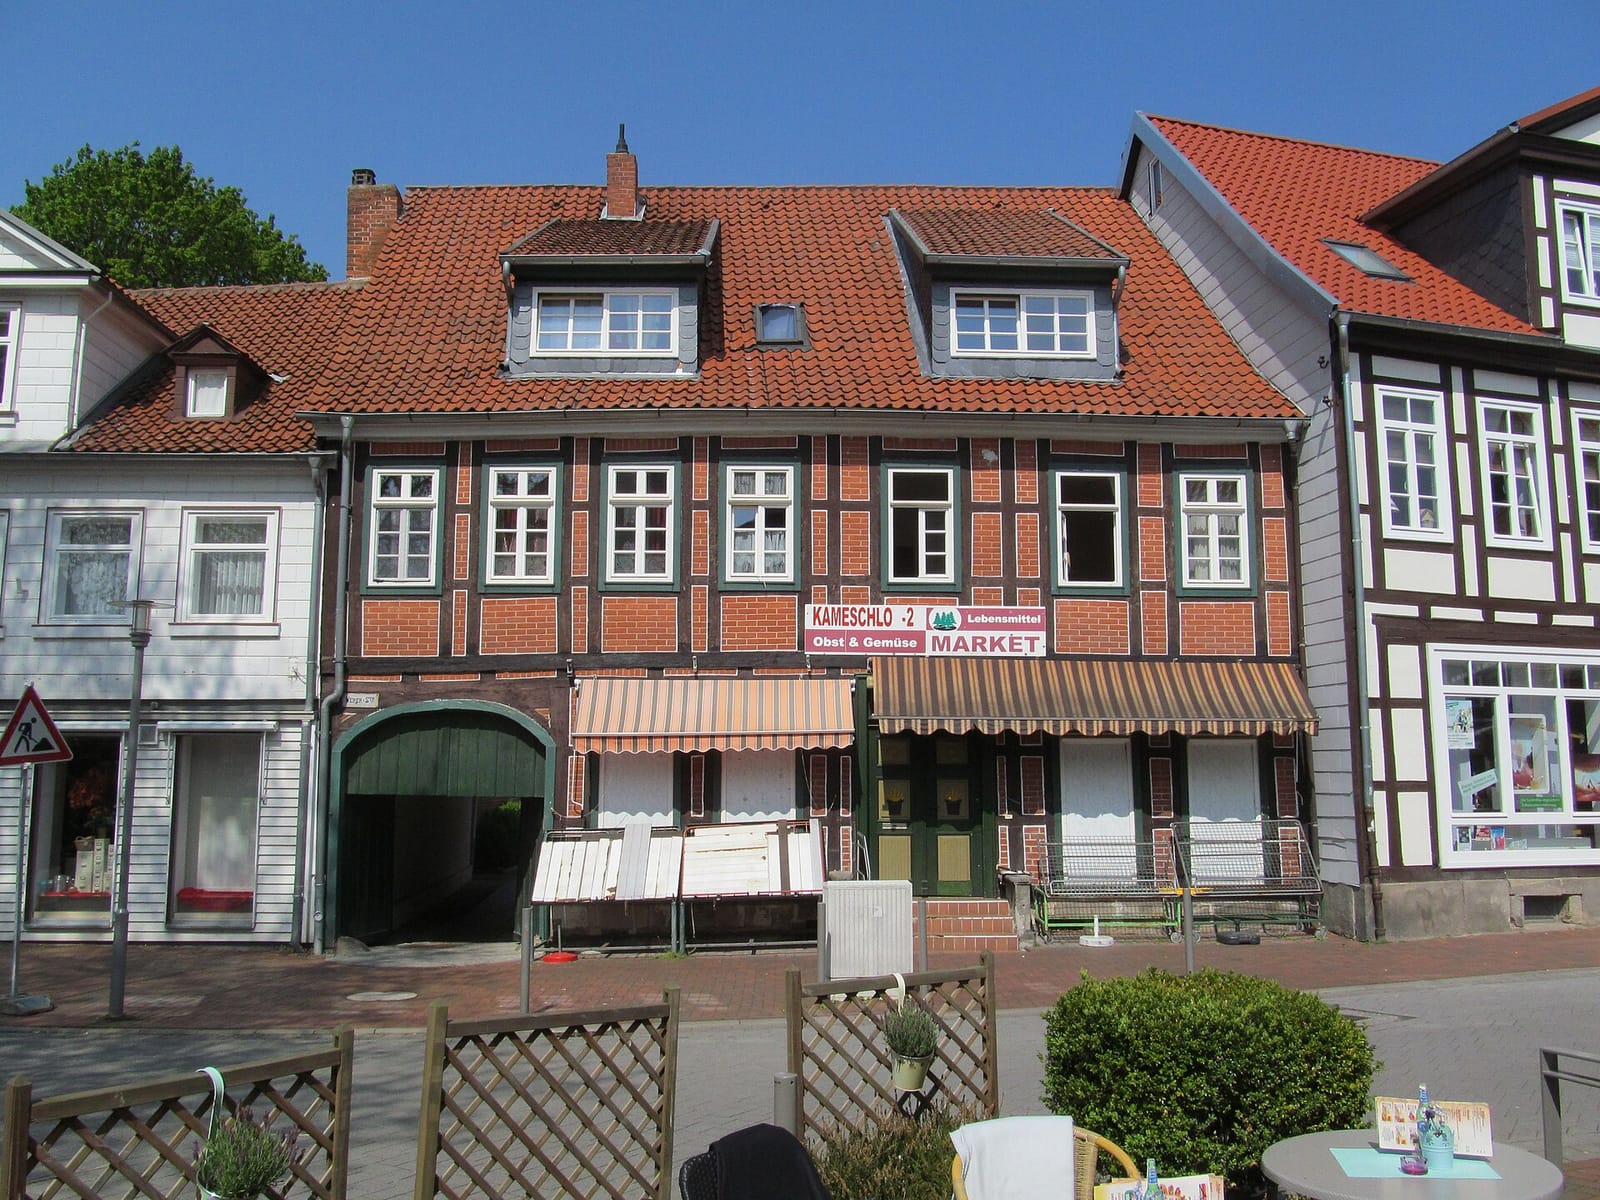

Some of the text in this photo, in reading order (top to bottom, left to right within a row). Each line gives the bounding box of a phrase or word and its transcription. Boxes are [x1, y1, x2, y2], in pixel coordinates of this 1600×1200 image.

[813, 606, 892, 627] KAMESCHLO
[967, 614, 1041, 624] Lebensmittel
[813, 636, 917, 648] Obst & Gemüse
[931, 635, 1040, 652] MARKET
